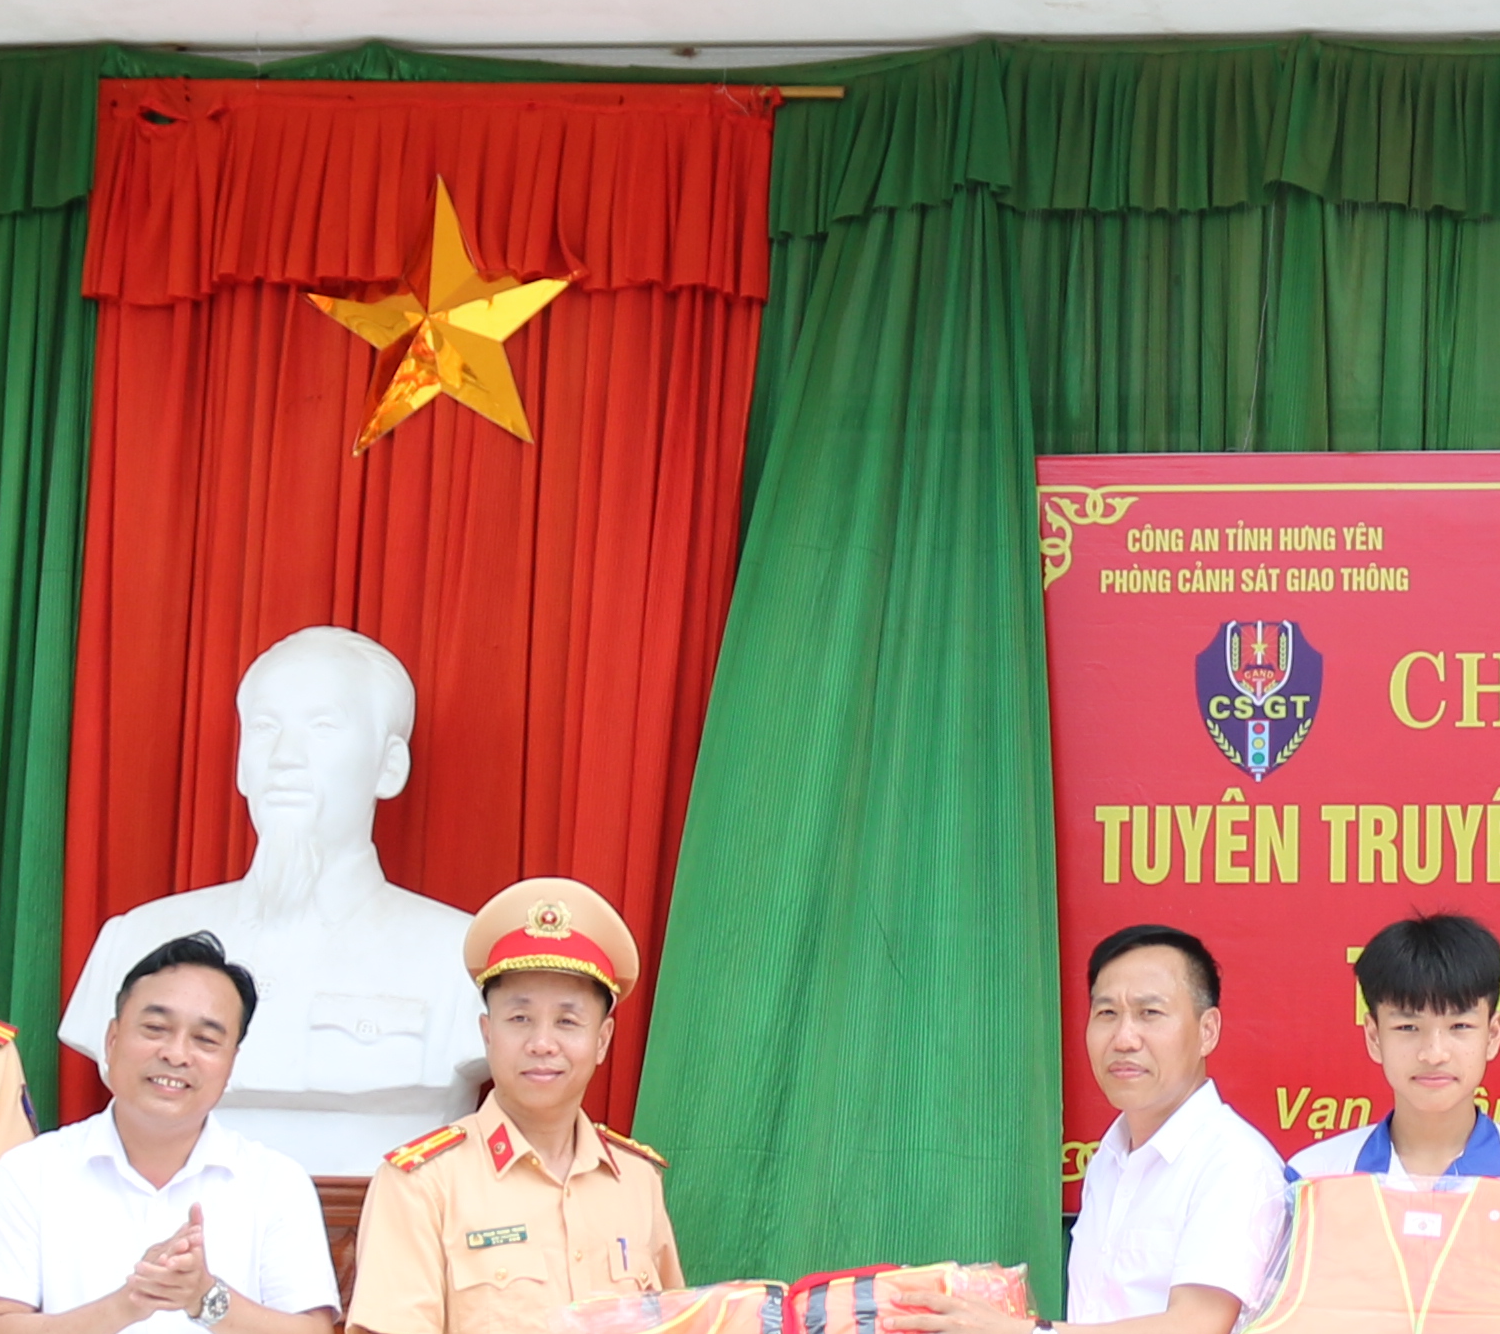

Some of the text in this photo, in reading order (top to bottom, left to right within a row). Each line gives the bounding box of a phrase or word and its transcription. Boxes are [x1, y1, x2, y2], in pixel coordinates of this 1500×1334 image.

[1127, 520, 1384, 553] CÔNG AN TỈNH HƯNG YÊN
[1100, 560, 1411, 595] PHÒNG CẢNH SÁT GIAO THÔNG
[1095, 786, 1300, 885] TUYÊN
[1275, 1086, 1373, 1140] Vạn
